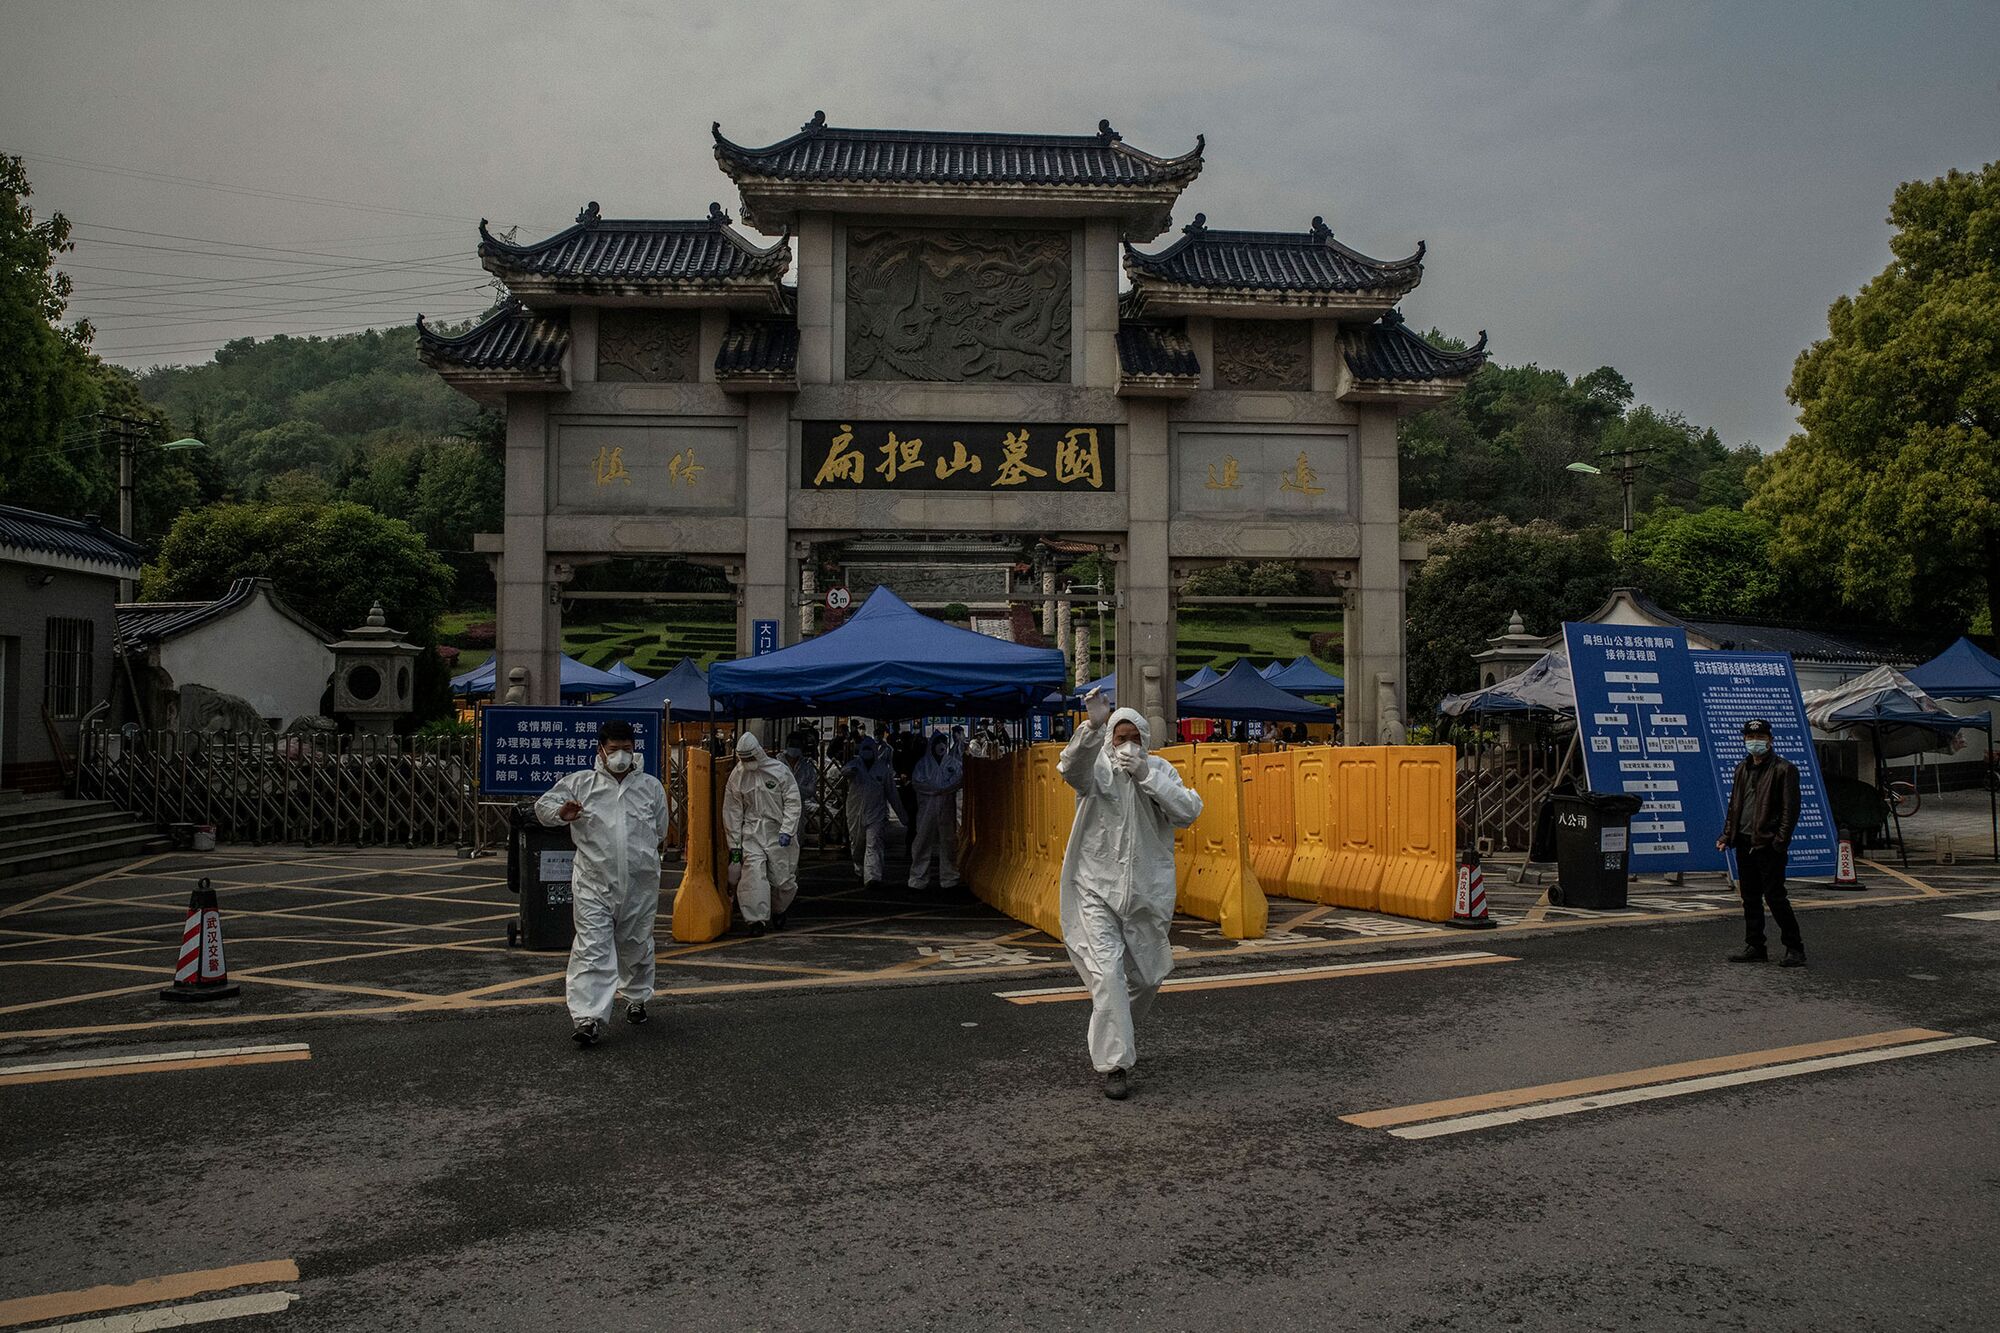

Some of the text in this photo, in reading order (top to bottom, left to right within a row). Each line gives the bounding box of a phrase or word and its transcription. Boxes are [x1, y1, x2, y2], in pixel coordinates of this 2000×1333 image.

[1583, 634, 1675, 649] 扁担山公墓疫情期间
[1606, 648, 1657, 662] 接待流程图
[517, 720, 649, 734] 疫情期间，按照定，
[496, 737, 645, 751] 办理购墓等手续客户限
[206, 917, 220, 972] 武汉交警
